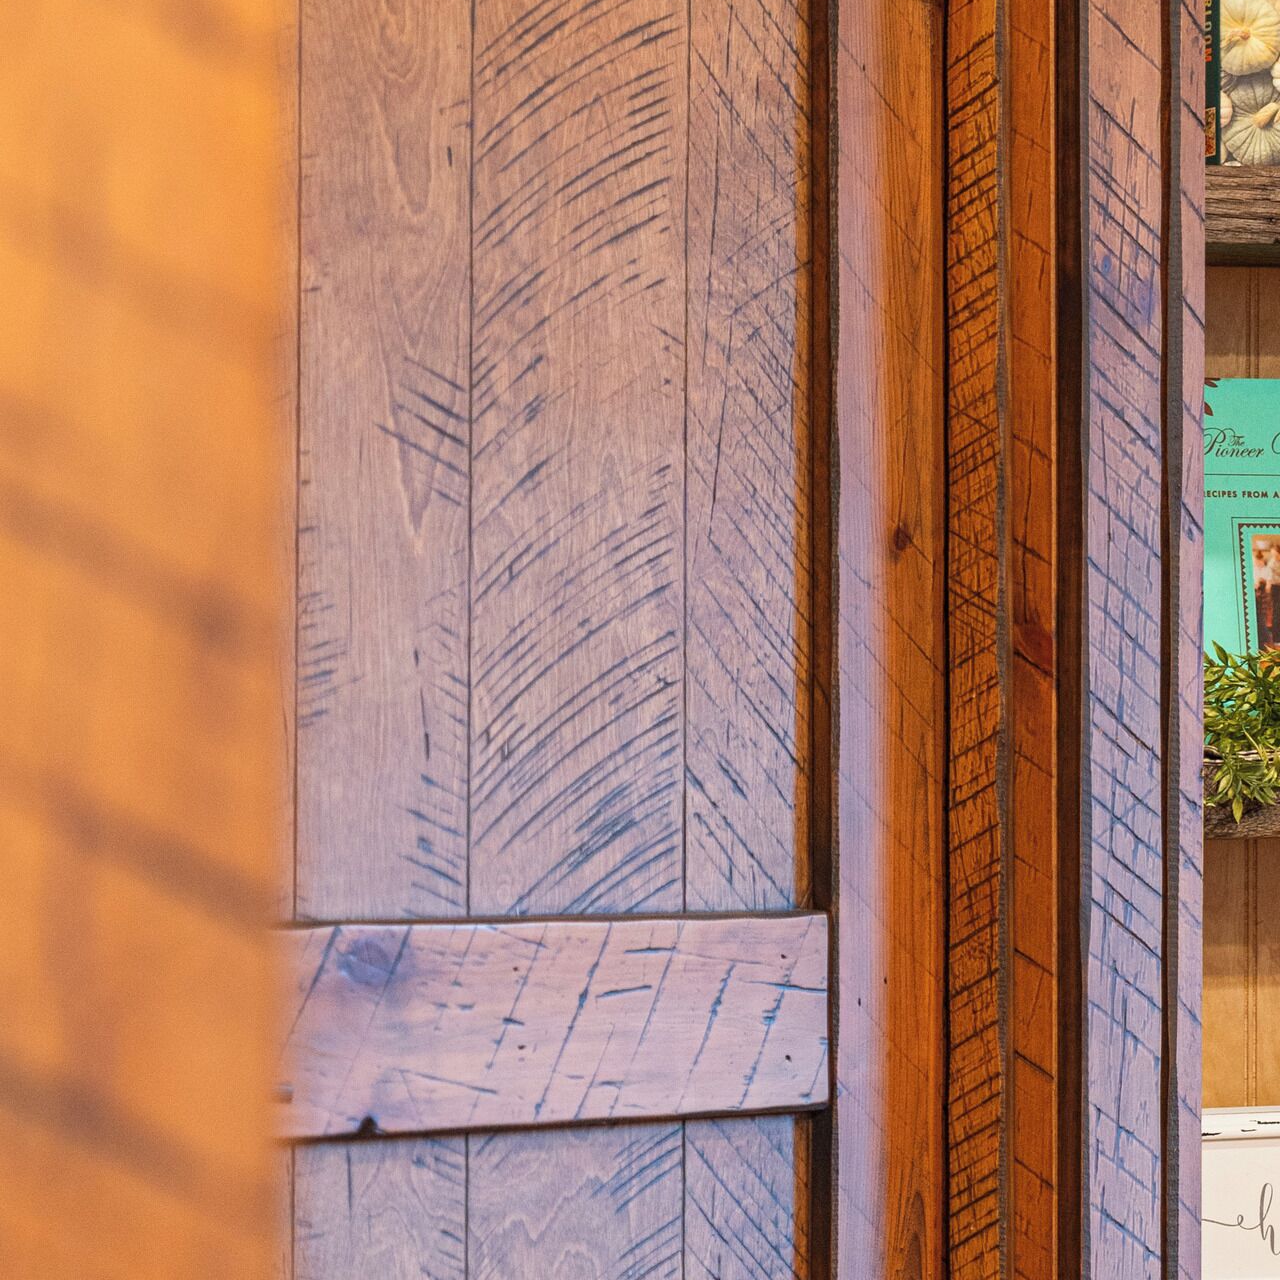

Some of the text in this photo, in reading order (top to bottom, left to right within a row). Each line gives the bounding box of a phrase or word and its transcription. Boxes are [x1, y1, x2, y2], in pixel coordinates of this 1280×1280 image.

[1203, 427, 1265, 458] Pioneer
[1228, 434, 1246, 447] The
[1241, 490, 1269, 499] FROM
